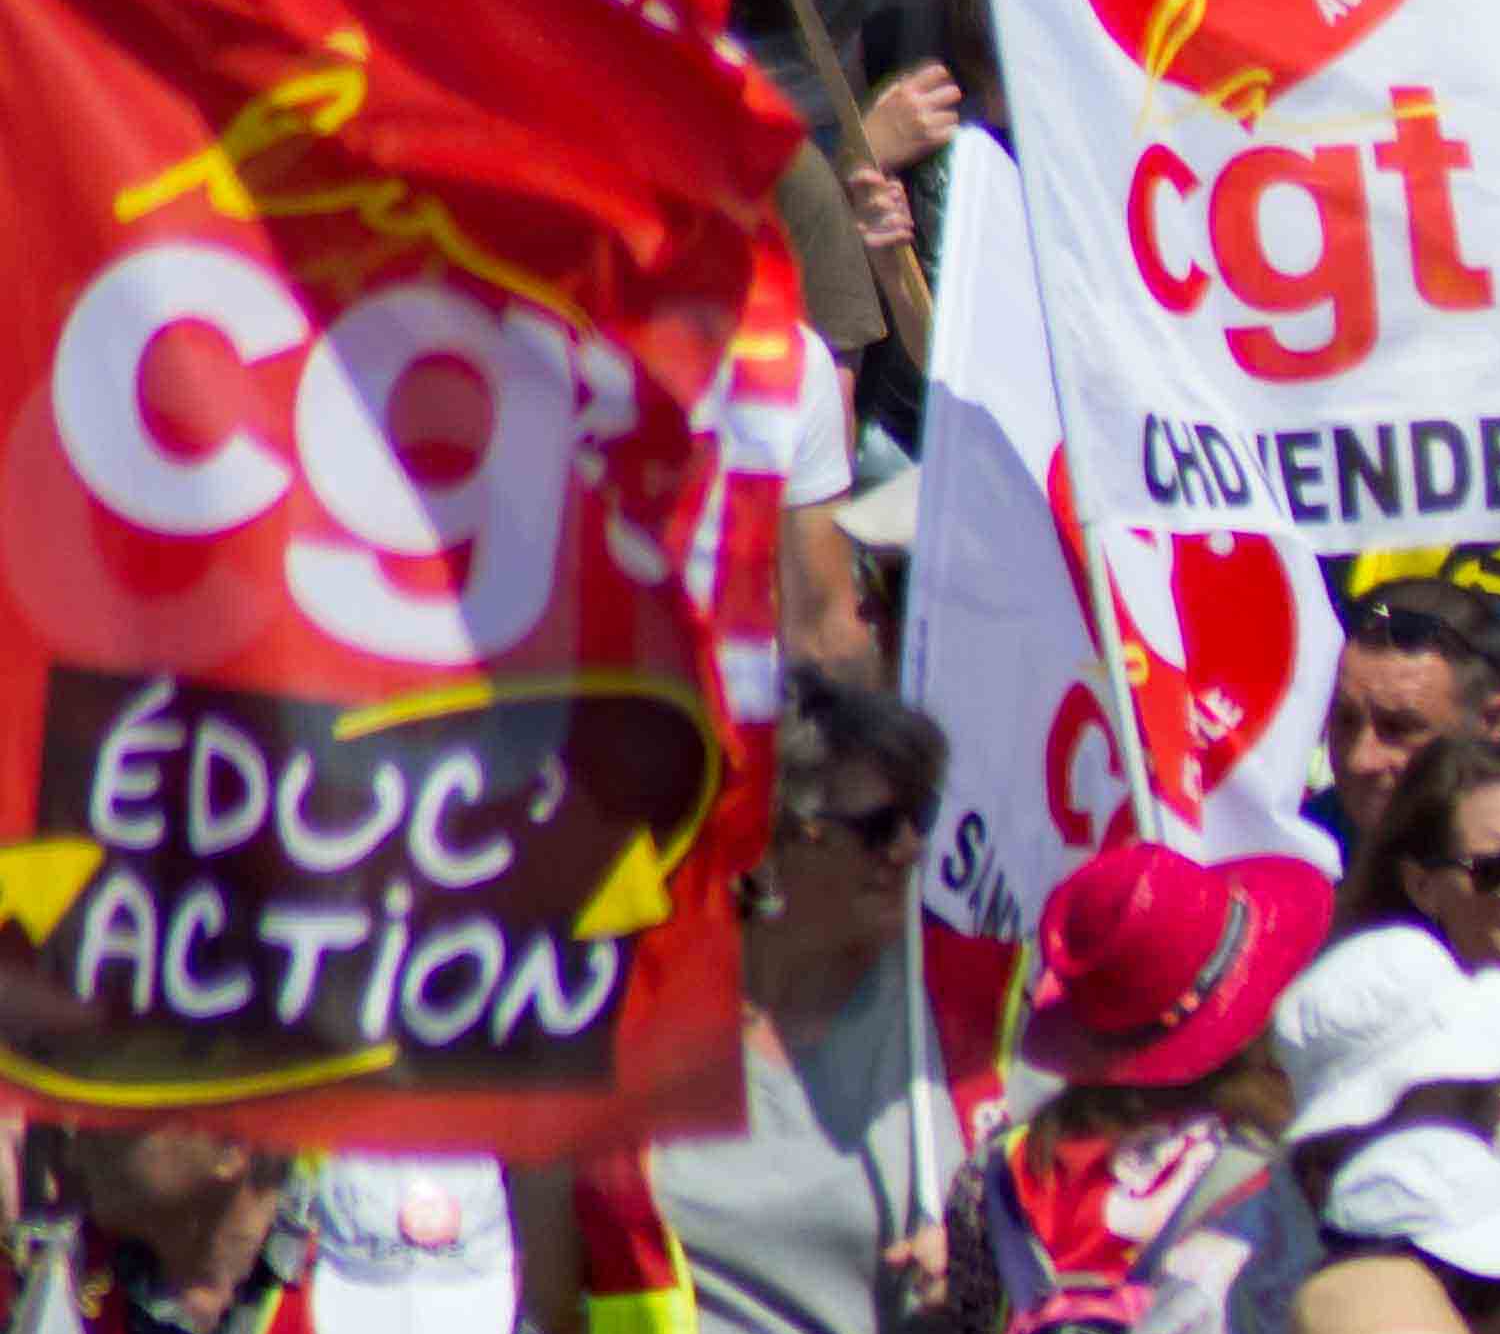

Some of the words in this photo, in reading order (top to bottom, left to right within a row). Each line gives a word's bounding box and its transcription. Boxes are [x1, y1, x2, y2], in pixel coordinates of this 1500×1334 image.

[1126, 83, 1494, 385] cgt
[50, 237, 670, 668] cg
[1142, 409, 1252, 510] CHD
